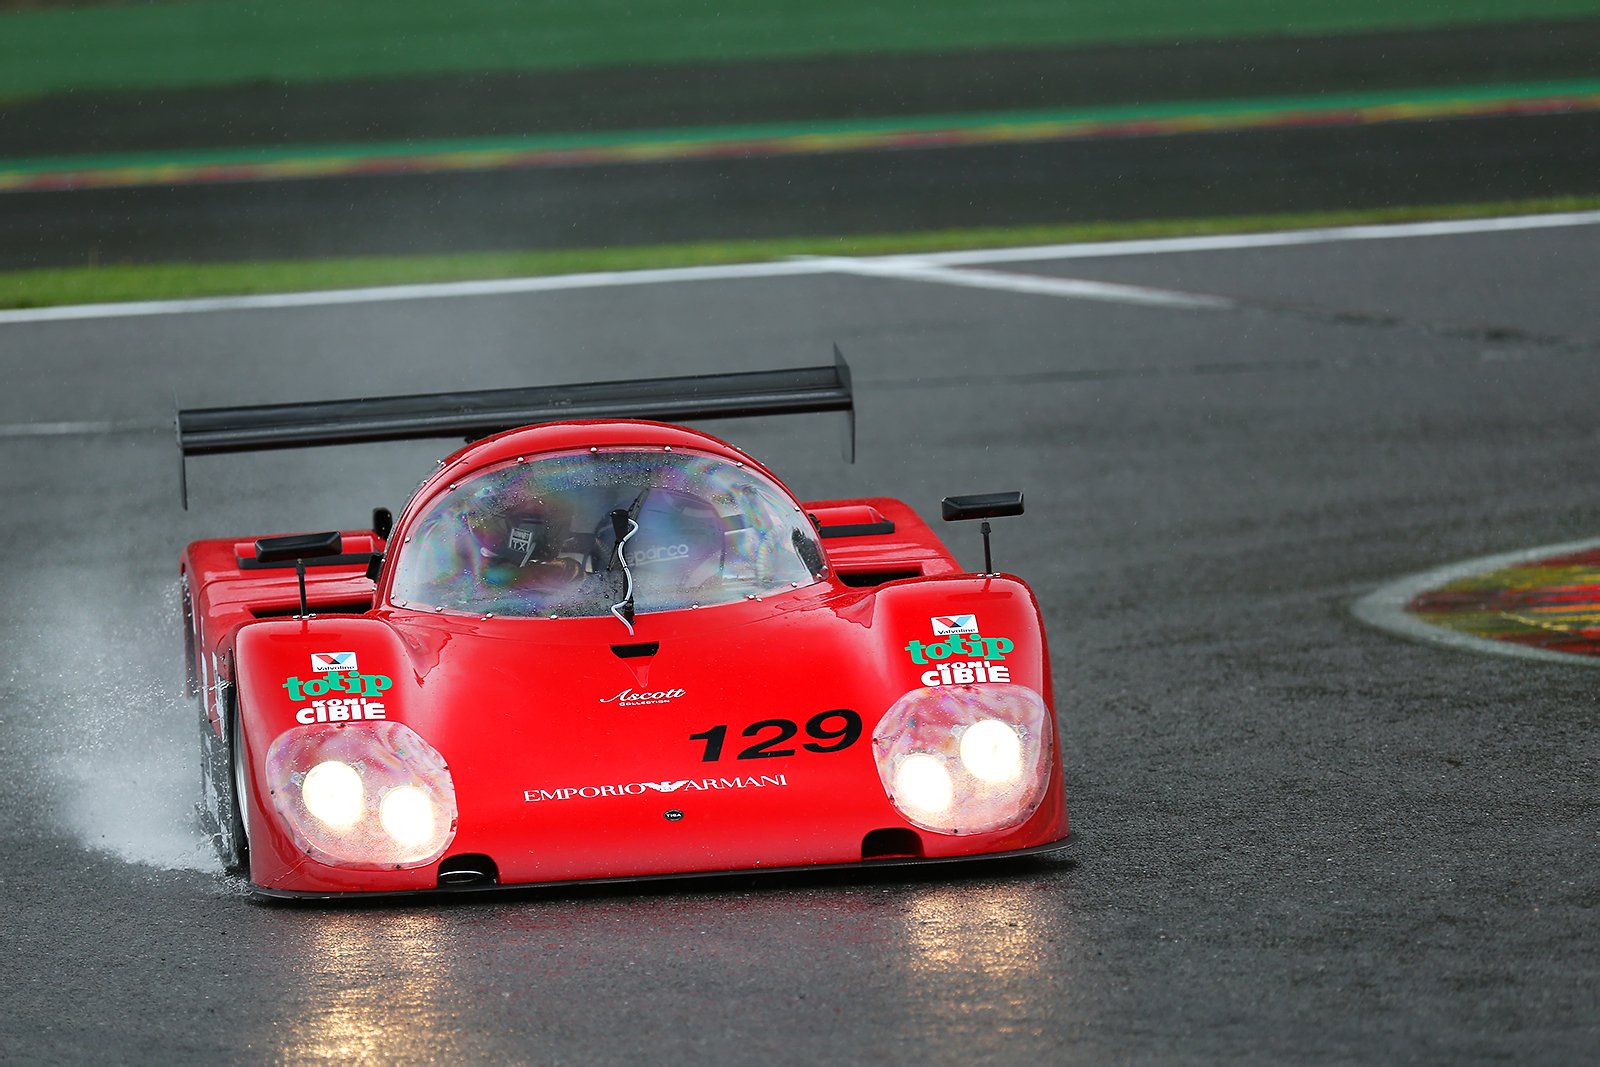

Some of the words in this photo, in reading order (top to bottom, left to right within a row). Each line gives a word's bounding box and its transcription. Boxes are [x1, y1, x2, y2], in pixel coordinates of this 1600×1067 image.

[904, 633, 1015, 665] totip
[282, 670, 393, 701] totip
[921, 665, 1011, 687] CIBIE
[599, 687, 686, 703] Ascott
[619, 699, 670, 707] COLLECTION
[295, 702, 386, 725] CIBIE
[688, 708, 863, 763] 129
[523, 782, 647, 803] EMPORIO
[684, 773, 788, 792] ARMANI
